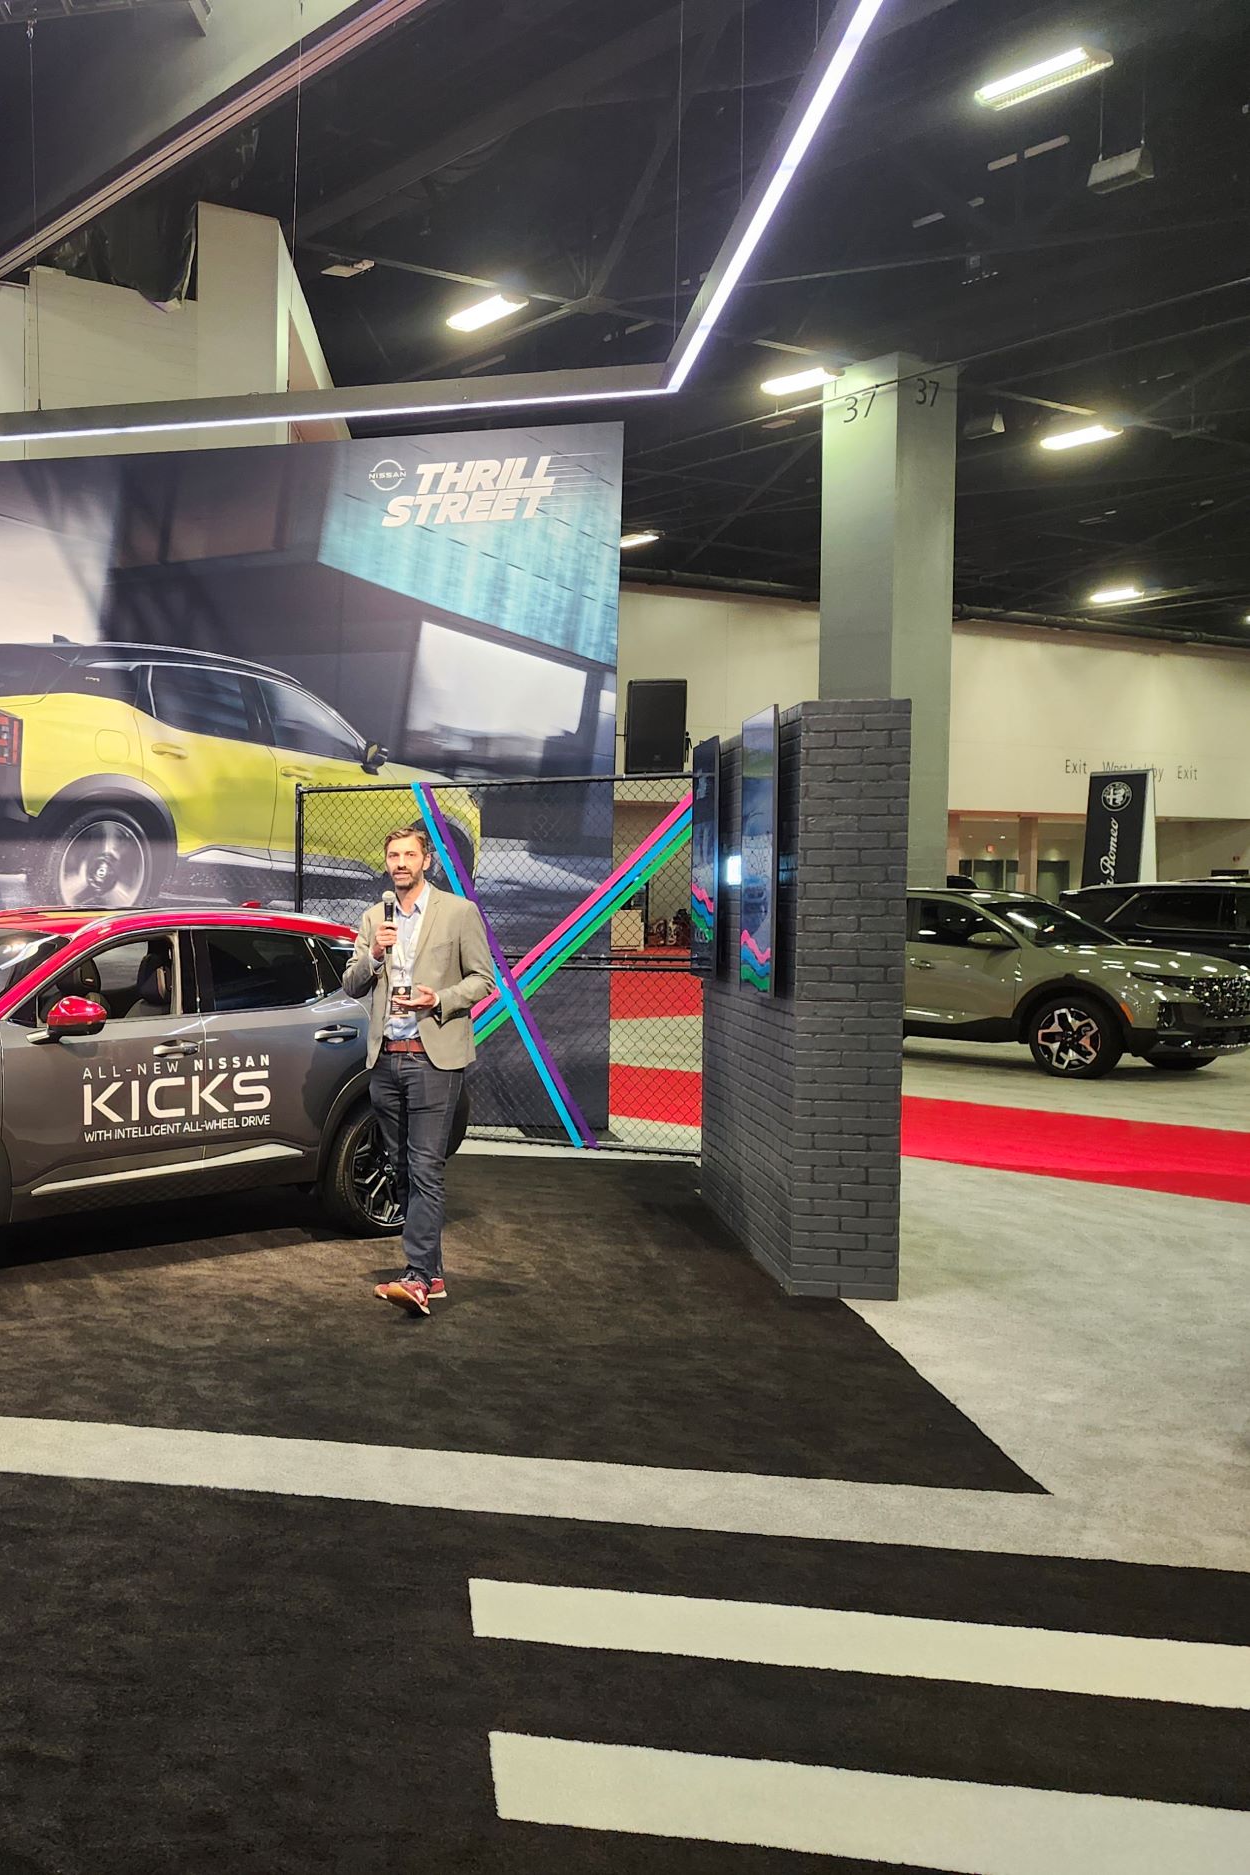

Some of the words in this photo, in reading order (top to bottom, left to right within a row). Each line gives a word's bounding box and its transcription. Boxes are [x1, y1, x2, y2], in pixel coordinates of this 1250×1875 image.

[843, 389, 877, 424] 37
[915, 378, 940, 408] 37
[369, 470, 406, 480] NISSAN
[415, 455, 555, 495] THRILL
[381, 487, 554, 528] STREET
[1065, 759, 1087, 774] Exit
[1177, 765, 1198, 781] Exit
[1100, 817, 1119, 877] Romeo
[83, 1062, 179, 1079] ALL-NEW
[194, 1054, 270, 1071] NISSAN
[83, 1070, 271, 1126] KICKS
[84, 1129, 112, 1143] WITH
[115, 1122, 182, 1139] INTELLIGENT
[183, 1117, 239, 1133] ALL-WHEEL
[242, 1114, 270, 1128] DRIVE
